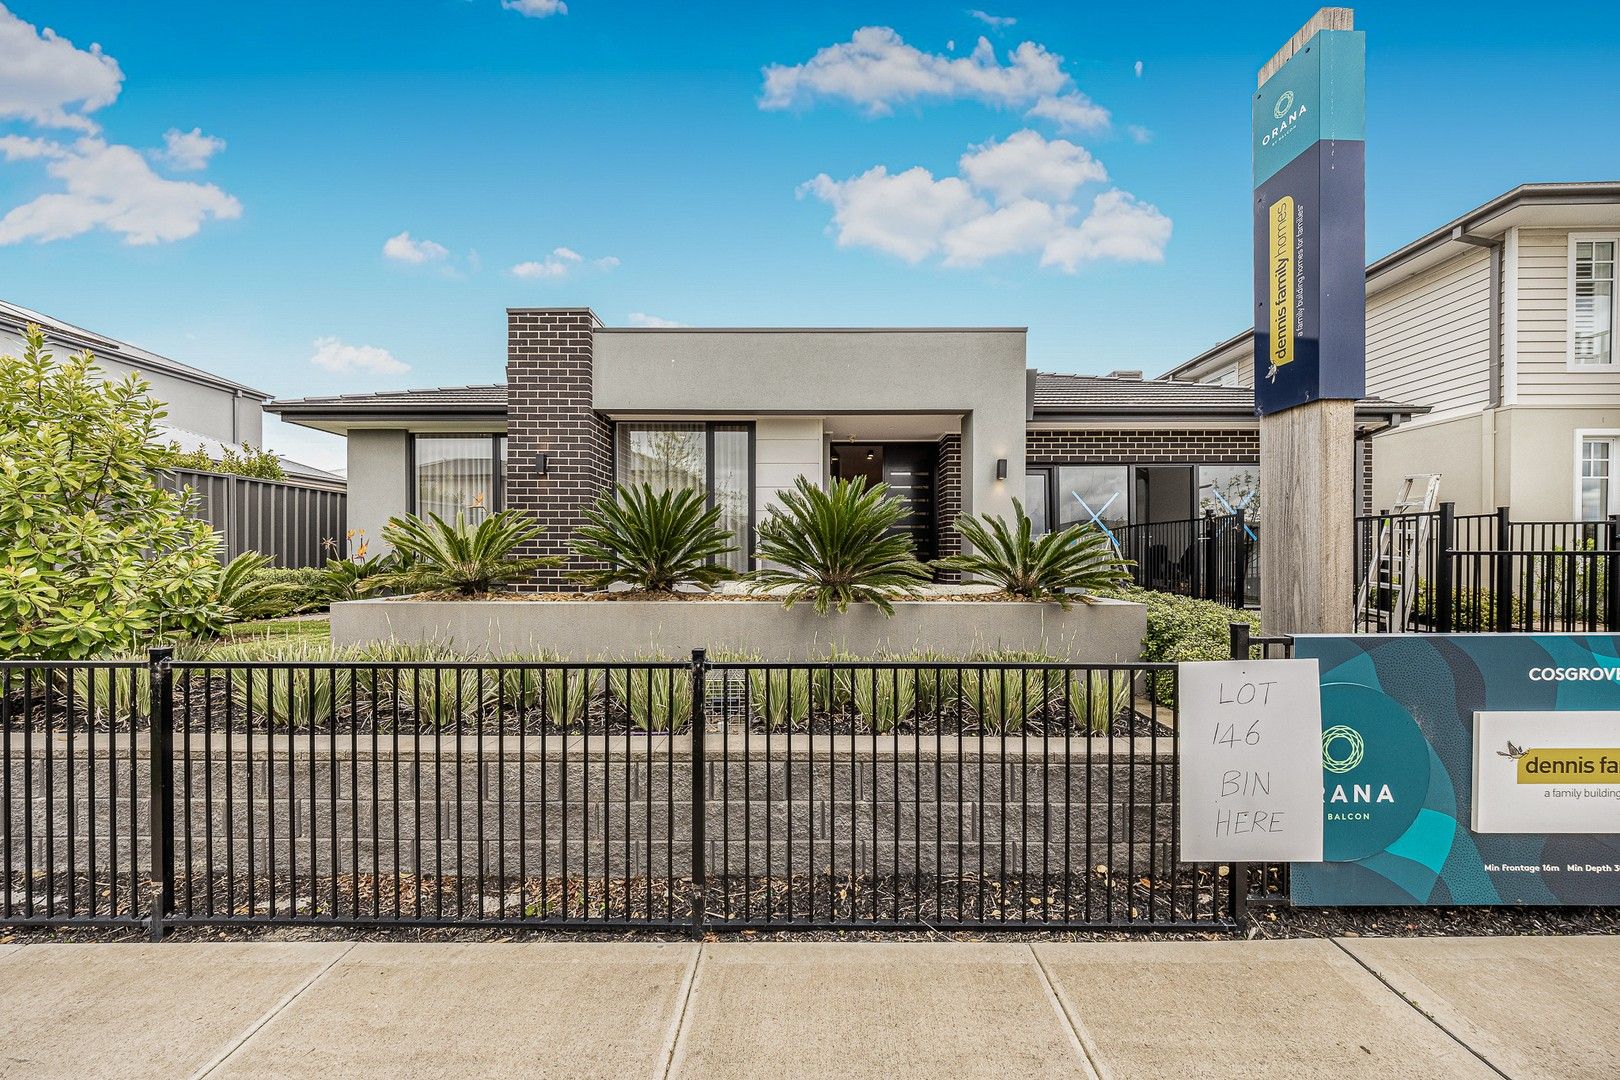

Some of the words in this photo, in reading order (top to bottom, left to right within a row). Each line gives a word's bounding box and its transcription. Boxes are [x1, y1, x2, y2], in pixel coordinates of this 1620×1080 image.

[1262, 104, 1307, 146] ORANA
[1274, 202, 1287, 258] homes
[1296, 237, 1304, 249] for
[1296, 249, 1304, 276] homes
[1275, 257, 1289, 306] family
[1296, 275, 1306, 307] building
[1275, 306, 1287, 359] dennis
[1296, 308, 1305, 332] family
[1219, 681, 1278, 706] LOT
[1212, 719, 1261, 748] 146
[1525, 756, 1595, 774] dennis
[1599, 756, 1620, 774] fa
[1220, 769, 1270, 797] BIN
[1543, 789, 1551, 798] a
[1552, 788, 1581, 800] family
[1215, 809, 1285, 838] HERE
[1327, 813, 1370, 821] BALCON
[1484, 864, 1500, 872] Min
[1501, 864, 1541, 874] Frontage
[1542, 864, 1560, 872] 16m
[1567, 864, 1583, 872] Min
[1585, 864, 1612, 874] Depth
